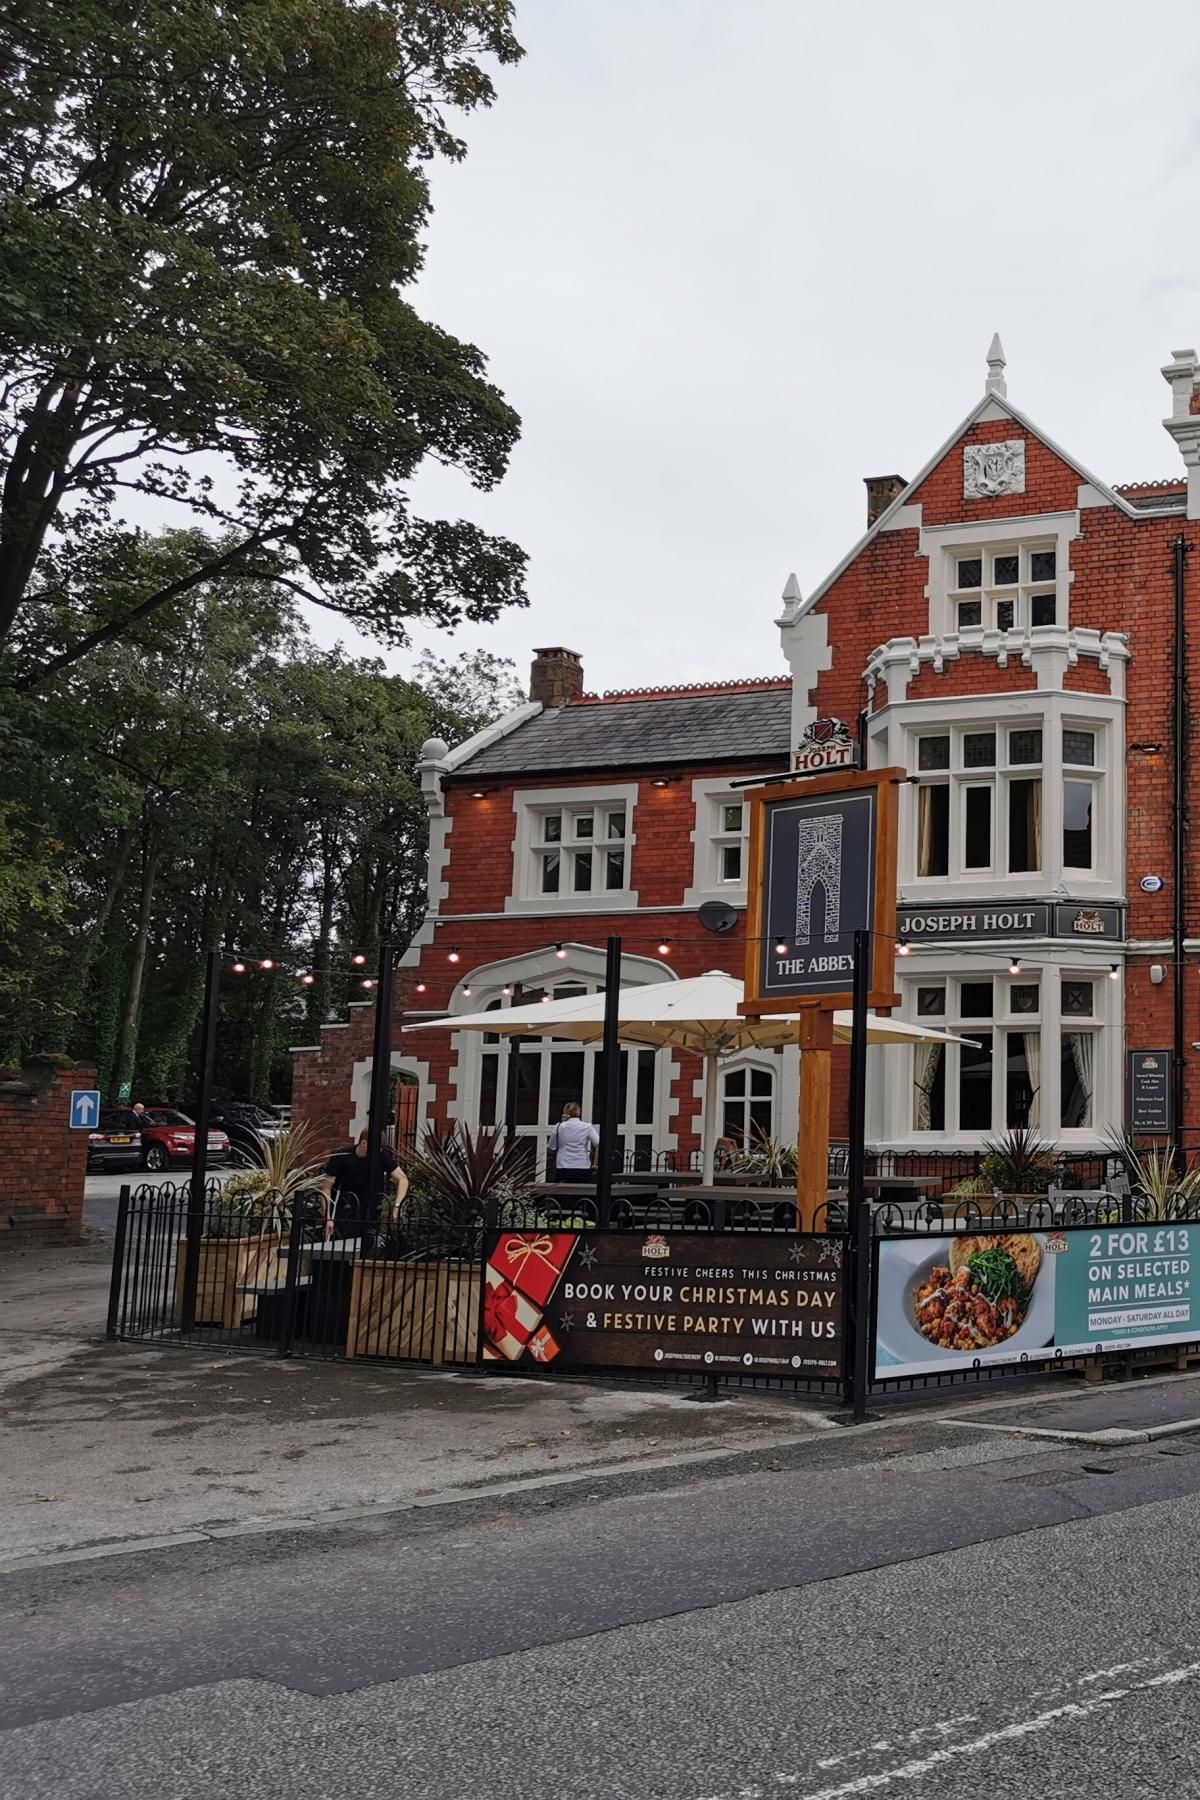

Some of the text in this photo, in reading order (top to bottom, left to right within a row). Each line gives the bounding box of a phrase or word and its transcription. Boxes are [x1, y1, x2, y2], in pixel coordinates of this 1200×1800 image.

[795, 748, 850, 770] HOLT
[901, 913, 1035, 933] JOSEPH HOLT
[1075, 922, 1102, 930] HOLT
[776, 954, 854, 975] THE ABBEY
[644, 1247, 669, 1255] HOLT
[1089, 1229, 1189, 1257] 2 FOR £13
[644, 1266, 837, 1282] FESTIVE CHEERS THIS CHRISTMAS
[1088, 1260, 1190, 1281] ON SELECTED
[564, 1282, 836, 1308] BOOK YOUR CHRISTMAS DAY
[1088, 1285, 1129, 1303] MAIN
[586, 1311, 836, 1339] & FESTIVE PARTY WITH US
[1090, 1315, 1122, 1326] MONDAY
[1126, 1311, 1162, 1323] SATURDAY
[1163, 1310, 1174, 1319] ALL
[1176, 1309, 1189, 1318] DAY
